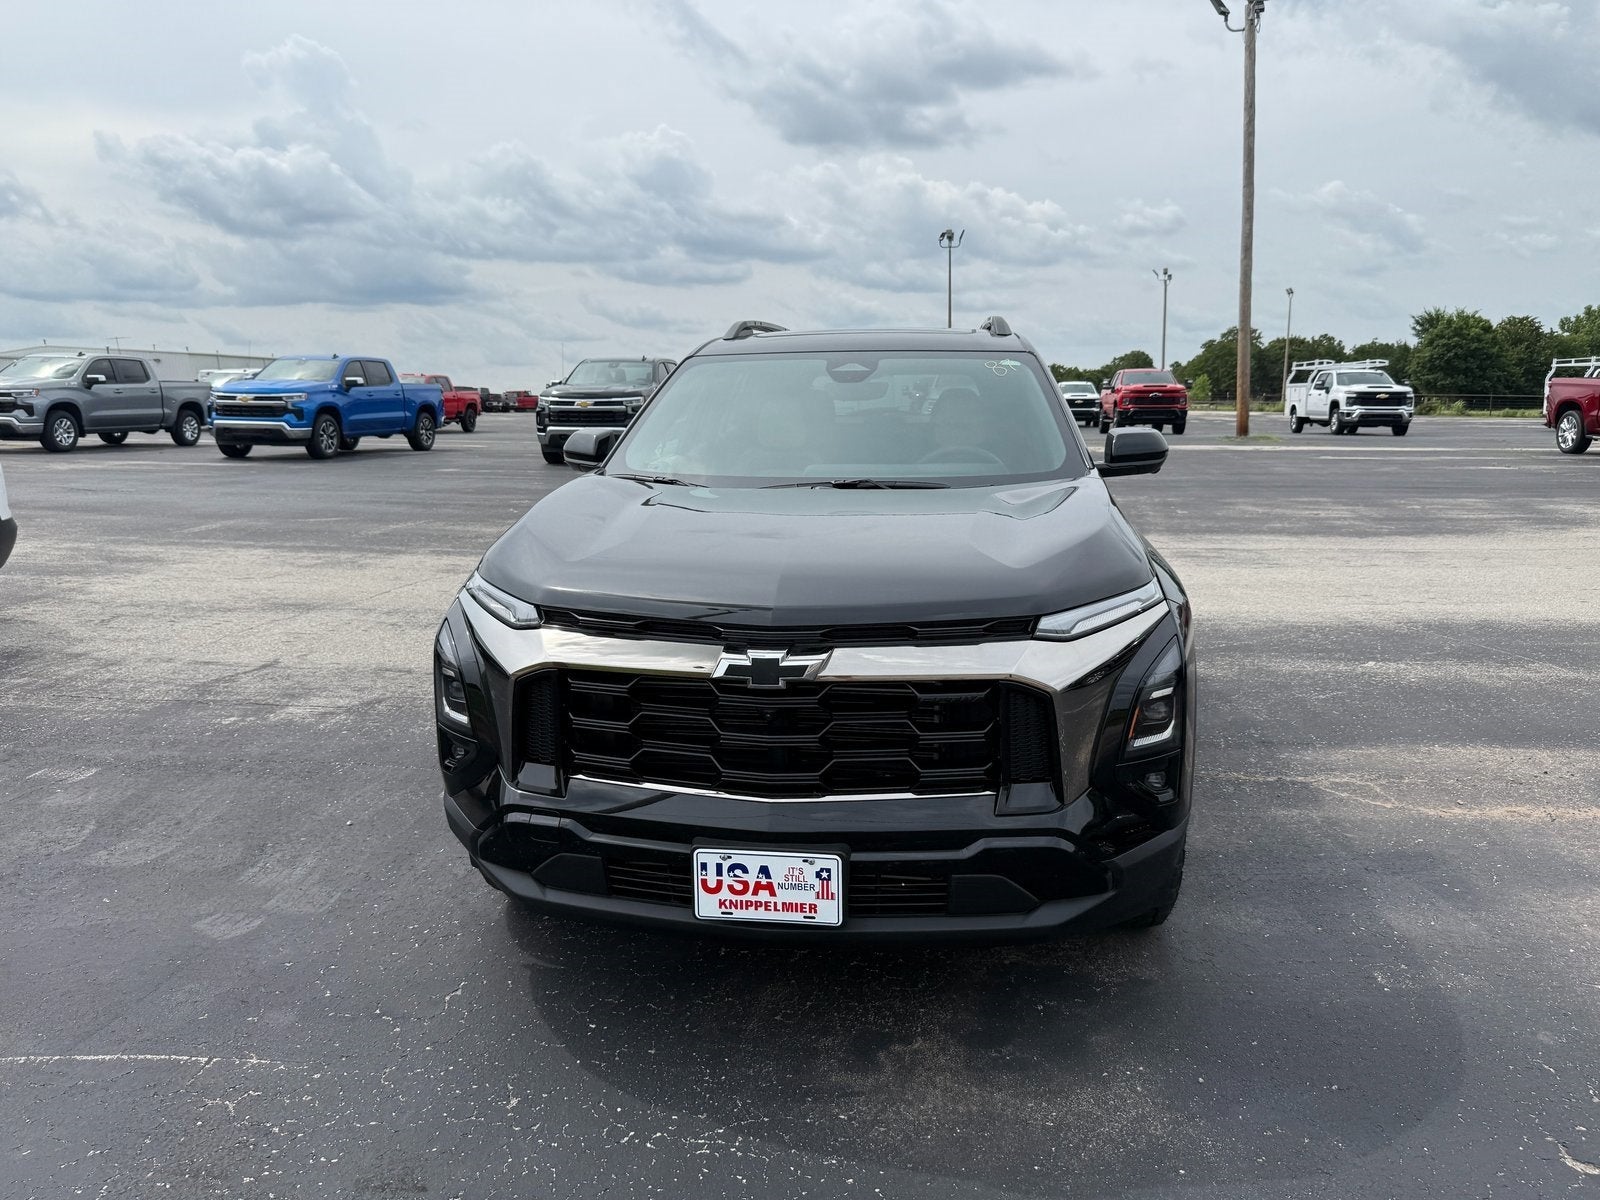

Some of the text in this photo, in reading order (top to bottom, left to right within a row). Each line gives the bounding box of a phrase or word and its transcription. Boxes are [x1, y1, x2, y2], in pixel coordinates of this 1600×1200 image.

[788, 867, 804, 876] IT'S
[700, 862, 777, 897] USA
[784, 875, 808, 883] STILL
[777, 882, 815, 891] NUMBER
[718, 898, 818, 914] KNIPPELMIER
